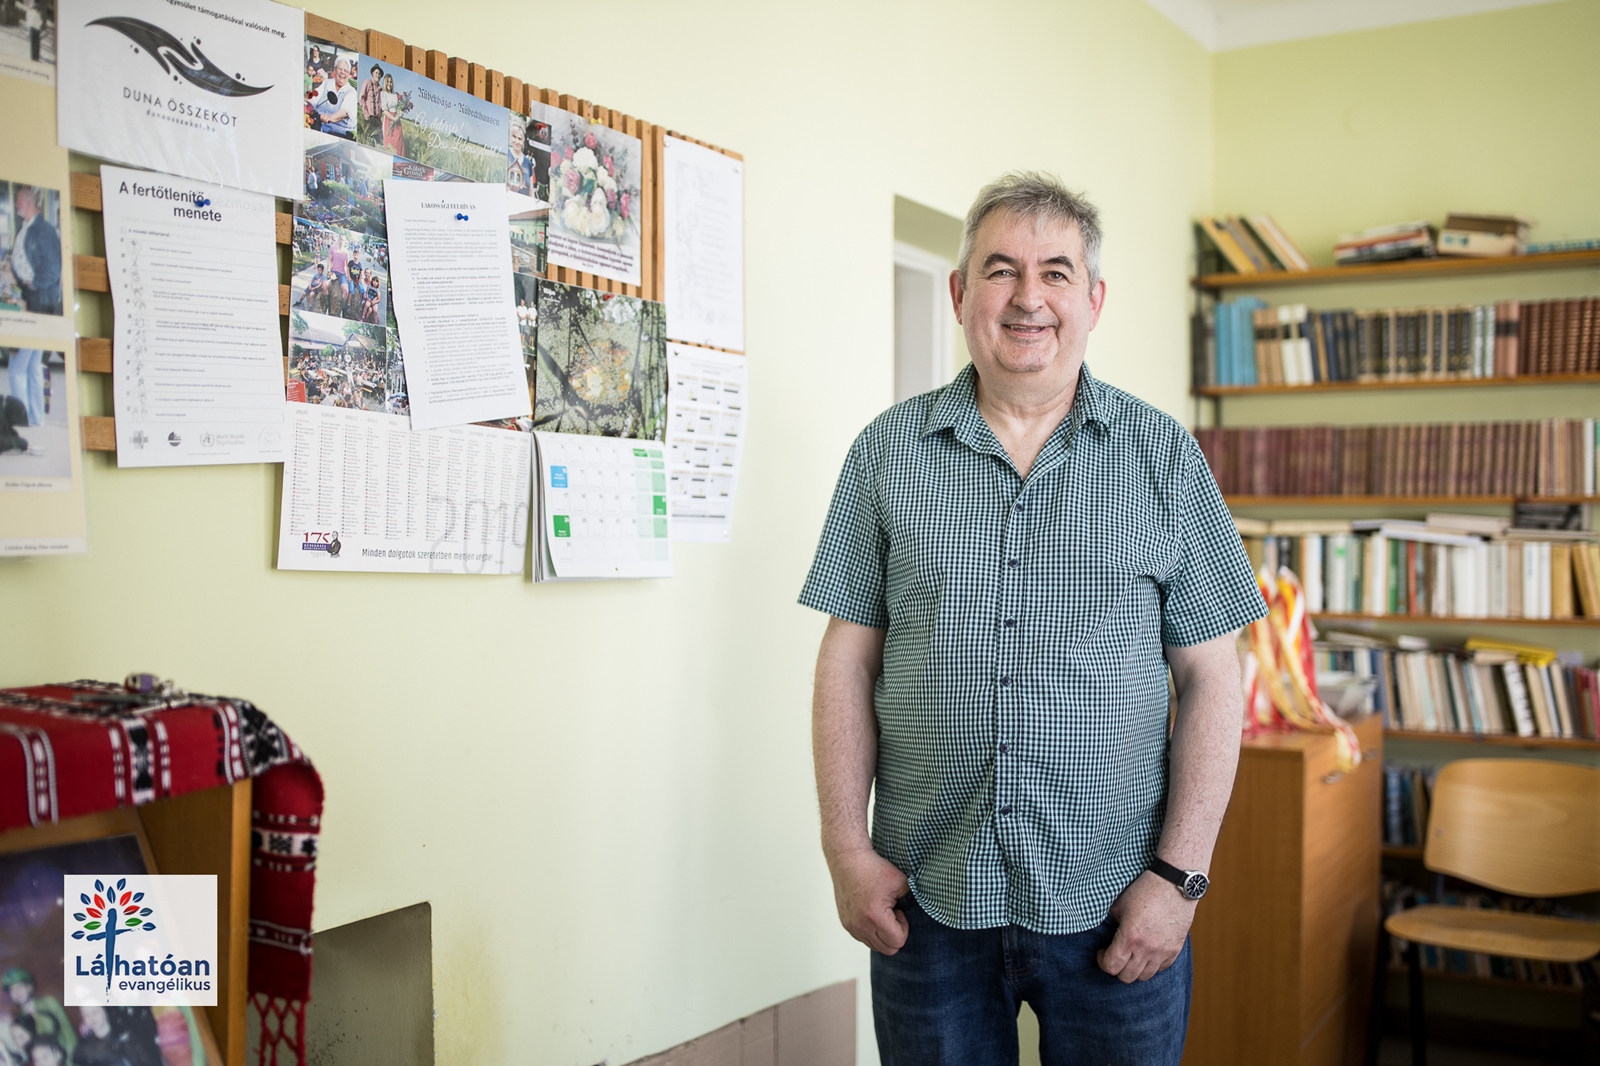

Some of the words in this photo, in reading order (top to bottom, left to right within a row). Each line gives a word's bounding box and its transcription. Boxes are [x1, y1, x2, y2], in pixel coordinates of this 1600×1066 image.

[166, 0, 196, 11] gyesület
[198, 6, 244, 26] támogatásával
[244, 20, 270, 34] valósult
[271, 28, 287, 39] meg.
[123, 86, 162, 108] DUNA
[167, 98, 237, 127] ÖSSZEKÖT
[119, 181, 129, 195] A
[132, 182, 205, 204] fertőtlenítő
[173, 206, 222, 222] menete
[361, 548, 387, 558] Minden
[387, 549, 416, 560] dolgotok
[417, 550, 452, 560] szeretetben
